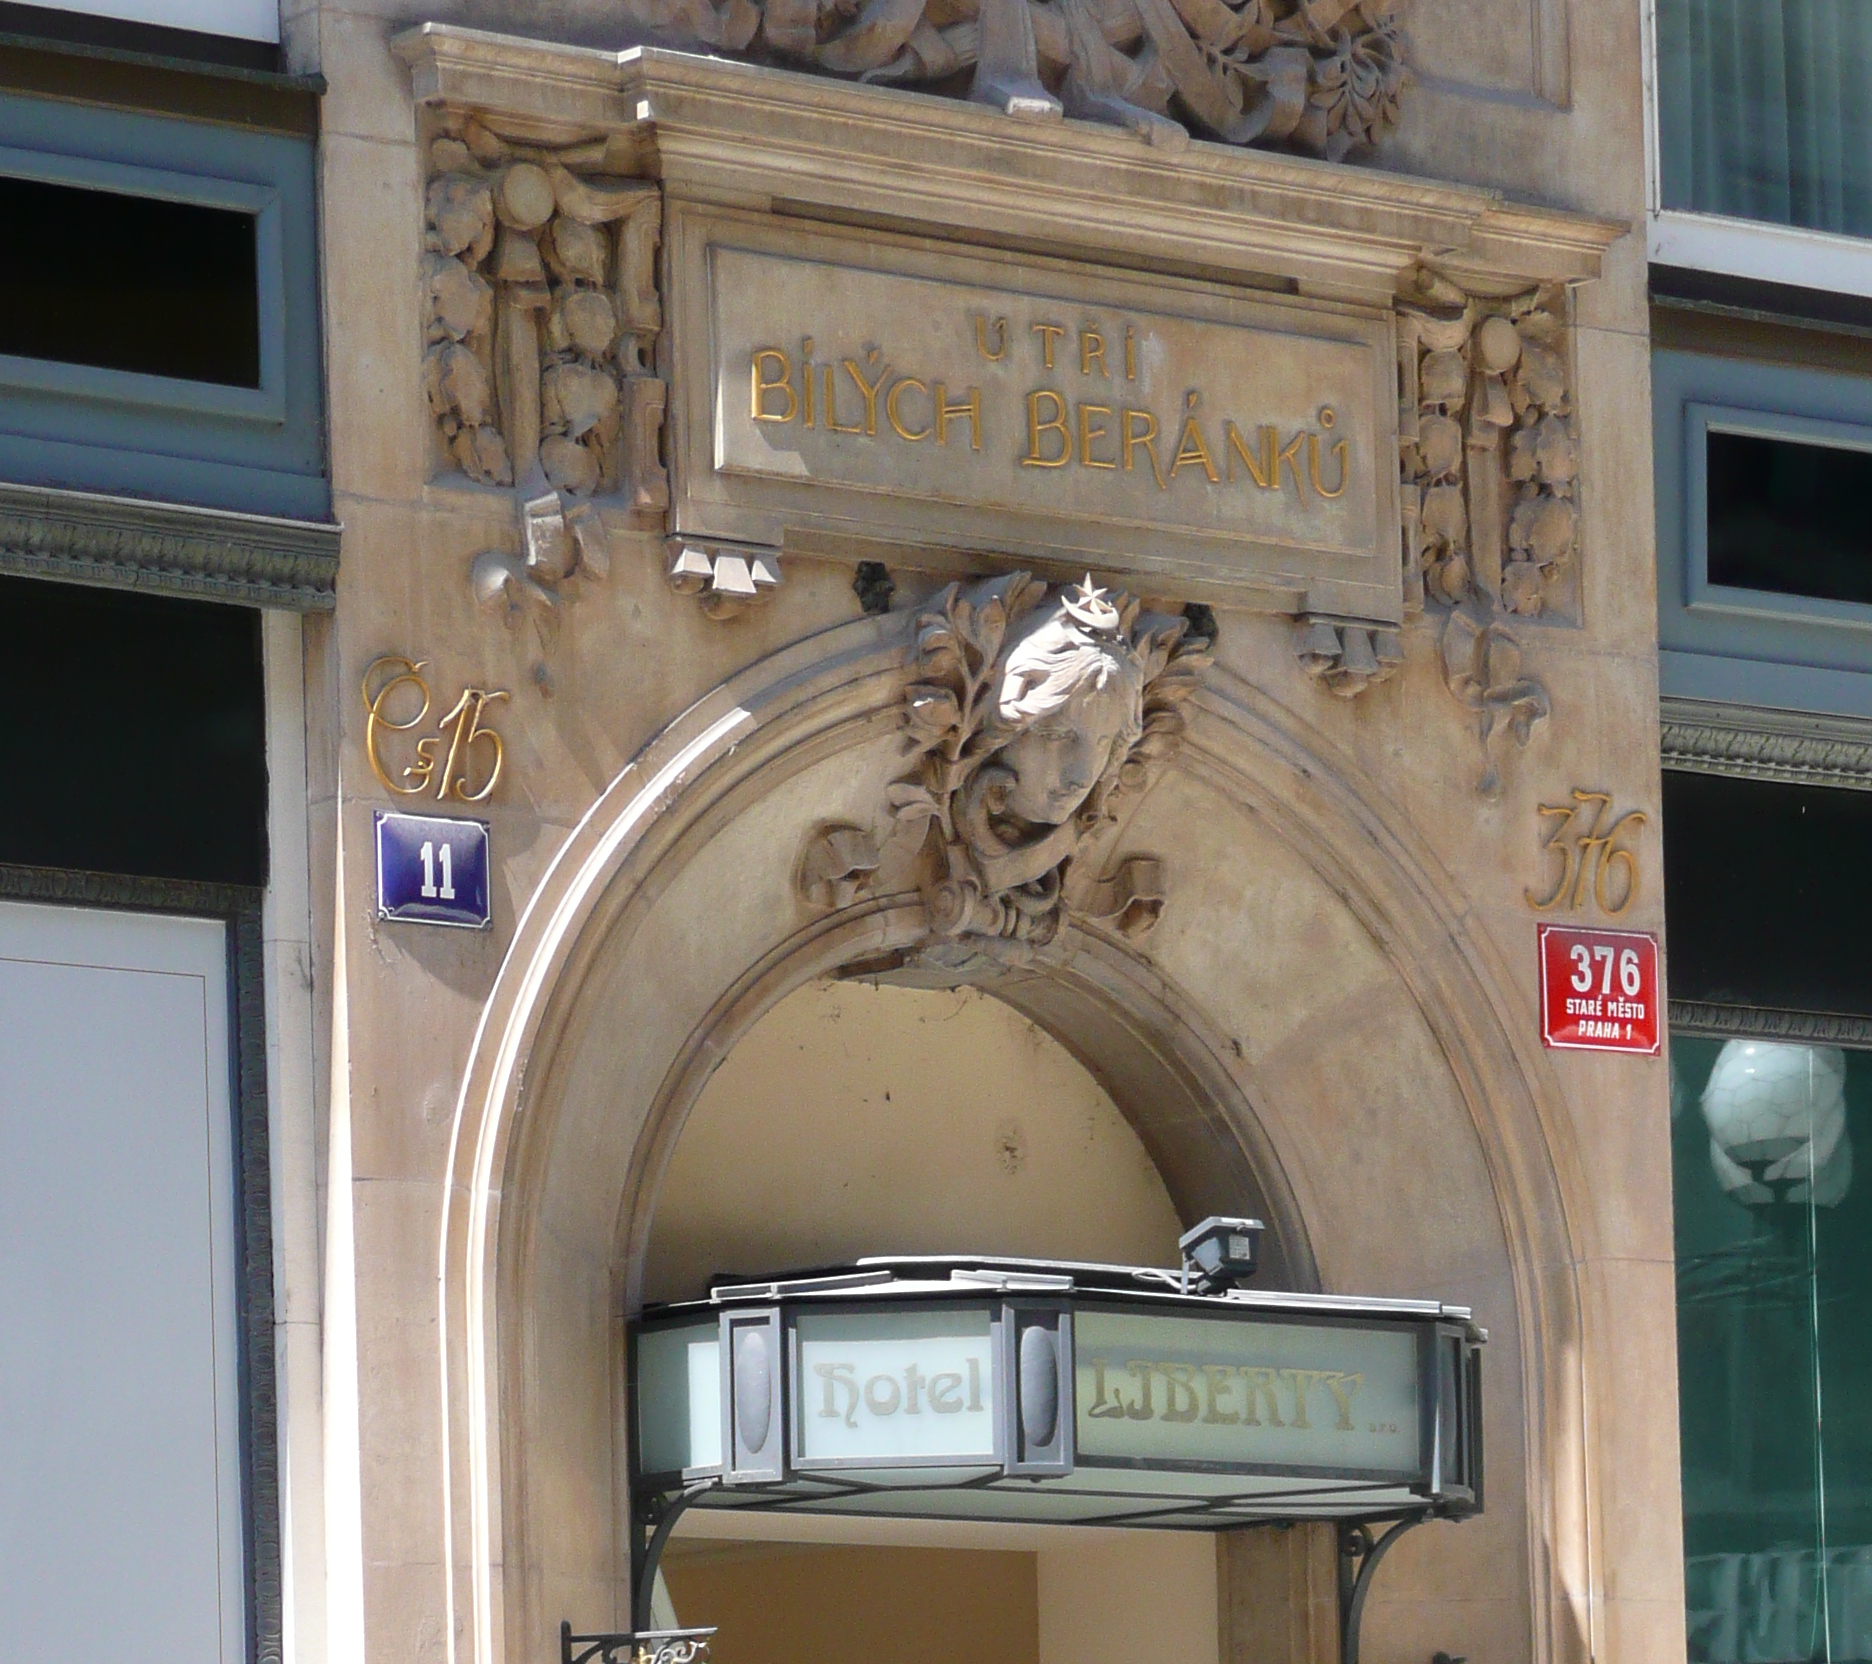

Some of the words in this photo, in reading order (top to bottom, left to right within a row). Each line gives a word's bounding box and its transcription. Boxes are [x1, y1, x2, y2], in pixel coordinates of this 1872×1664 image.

[751, 337, 981, 450] BÍLÝCH
[1021, 389, 1348, 507] BERÁNKŮ
[420, 841, 455, 900] 11
[1524, 787, 1646, 916] 376
[1570, 944, 1640, 996] 376
[1566, 994, 1602, 1016] STARÉ
[1607, 996, 1644, 1019] MĚSTO
[1578, 1019, 1620, 1039] PRAHA
[1625, 1023, 1632, 1040] 1
